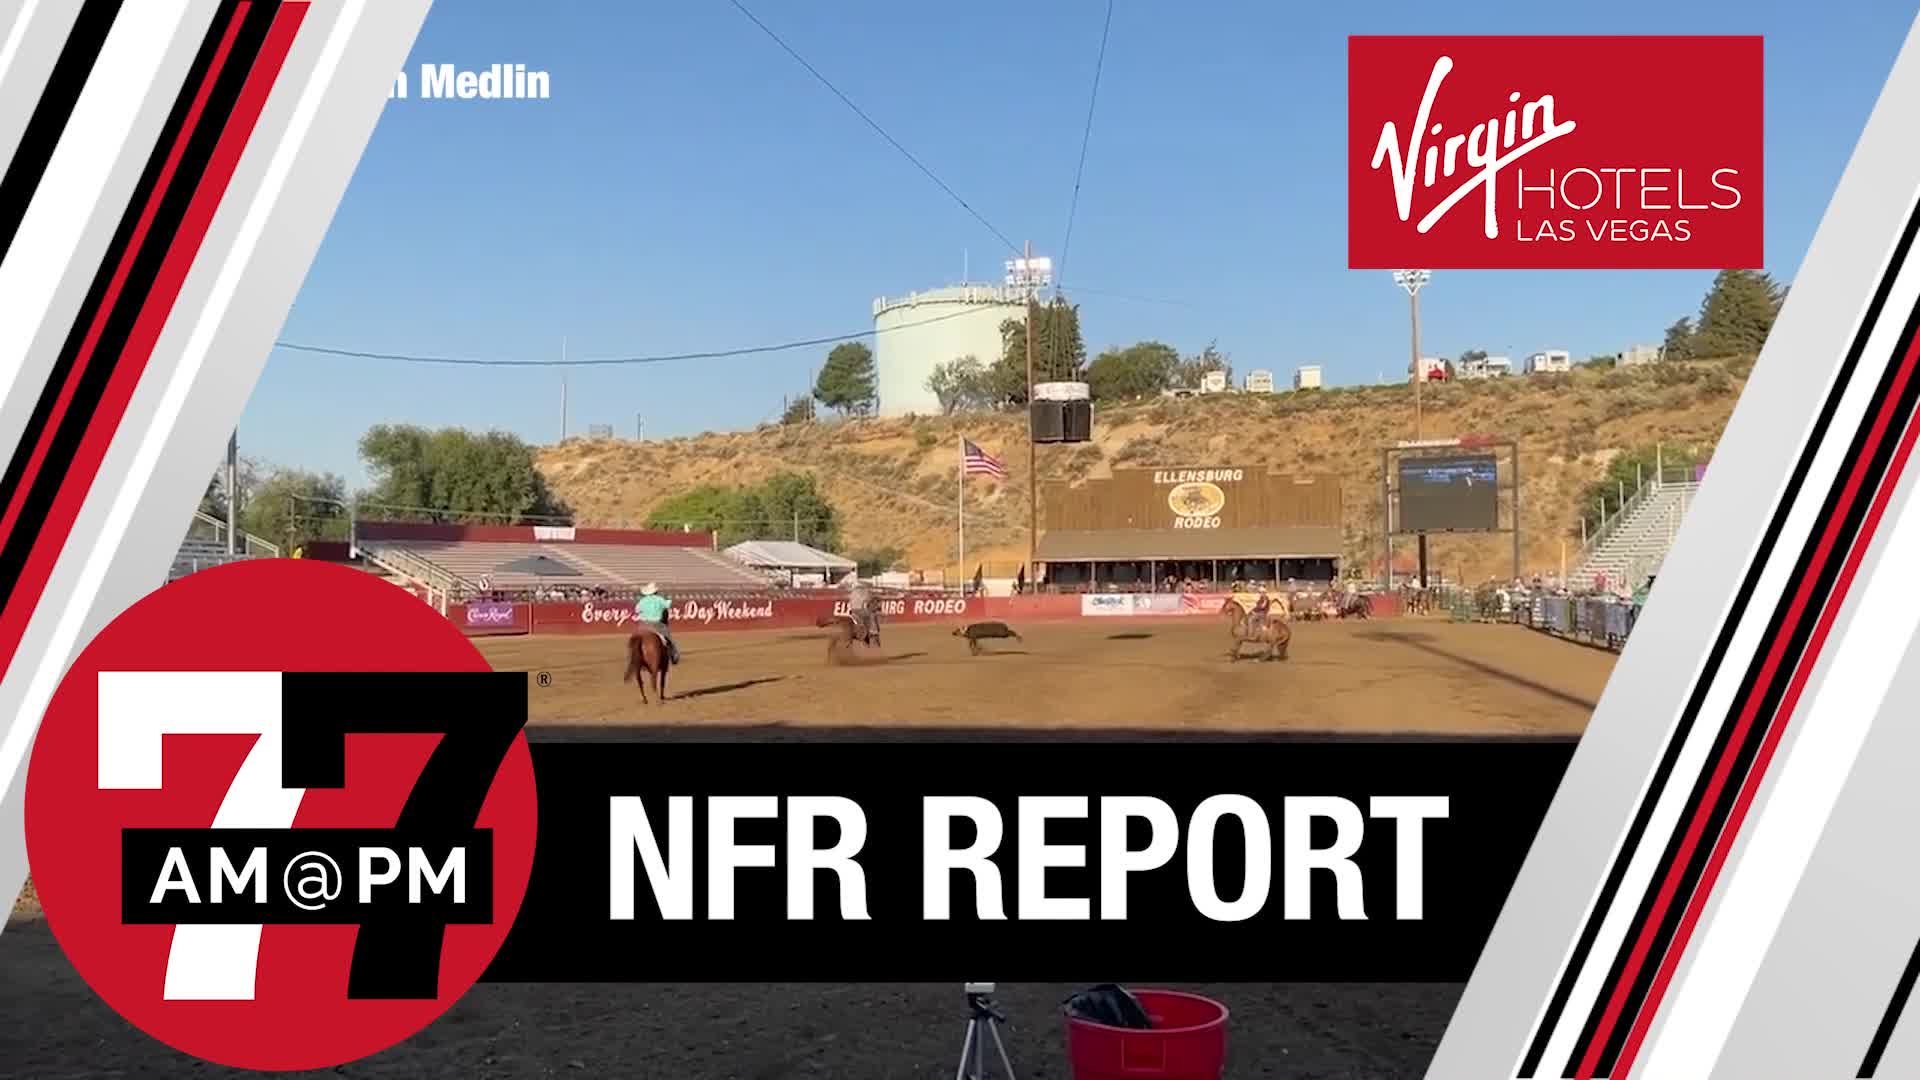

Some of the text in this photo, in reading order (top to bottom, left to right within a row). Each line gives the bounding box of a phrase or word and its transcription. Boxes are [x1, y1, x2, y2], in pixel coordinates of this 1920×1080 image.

[1154, 469, 1243, 484] ELLENSBURG
[1174, 516, 1221, 529] RODEO
[581, 602, 632, 627] Every
[684, 600, 716, 625] Day
[713, 600, 773, 620] Weekend
[914, 599, 966, 614] RODEO
